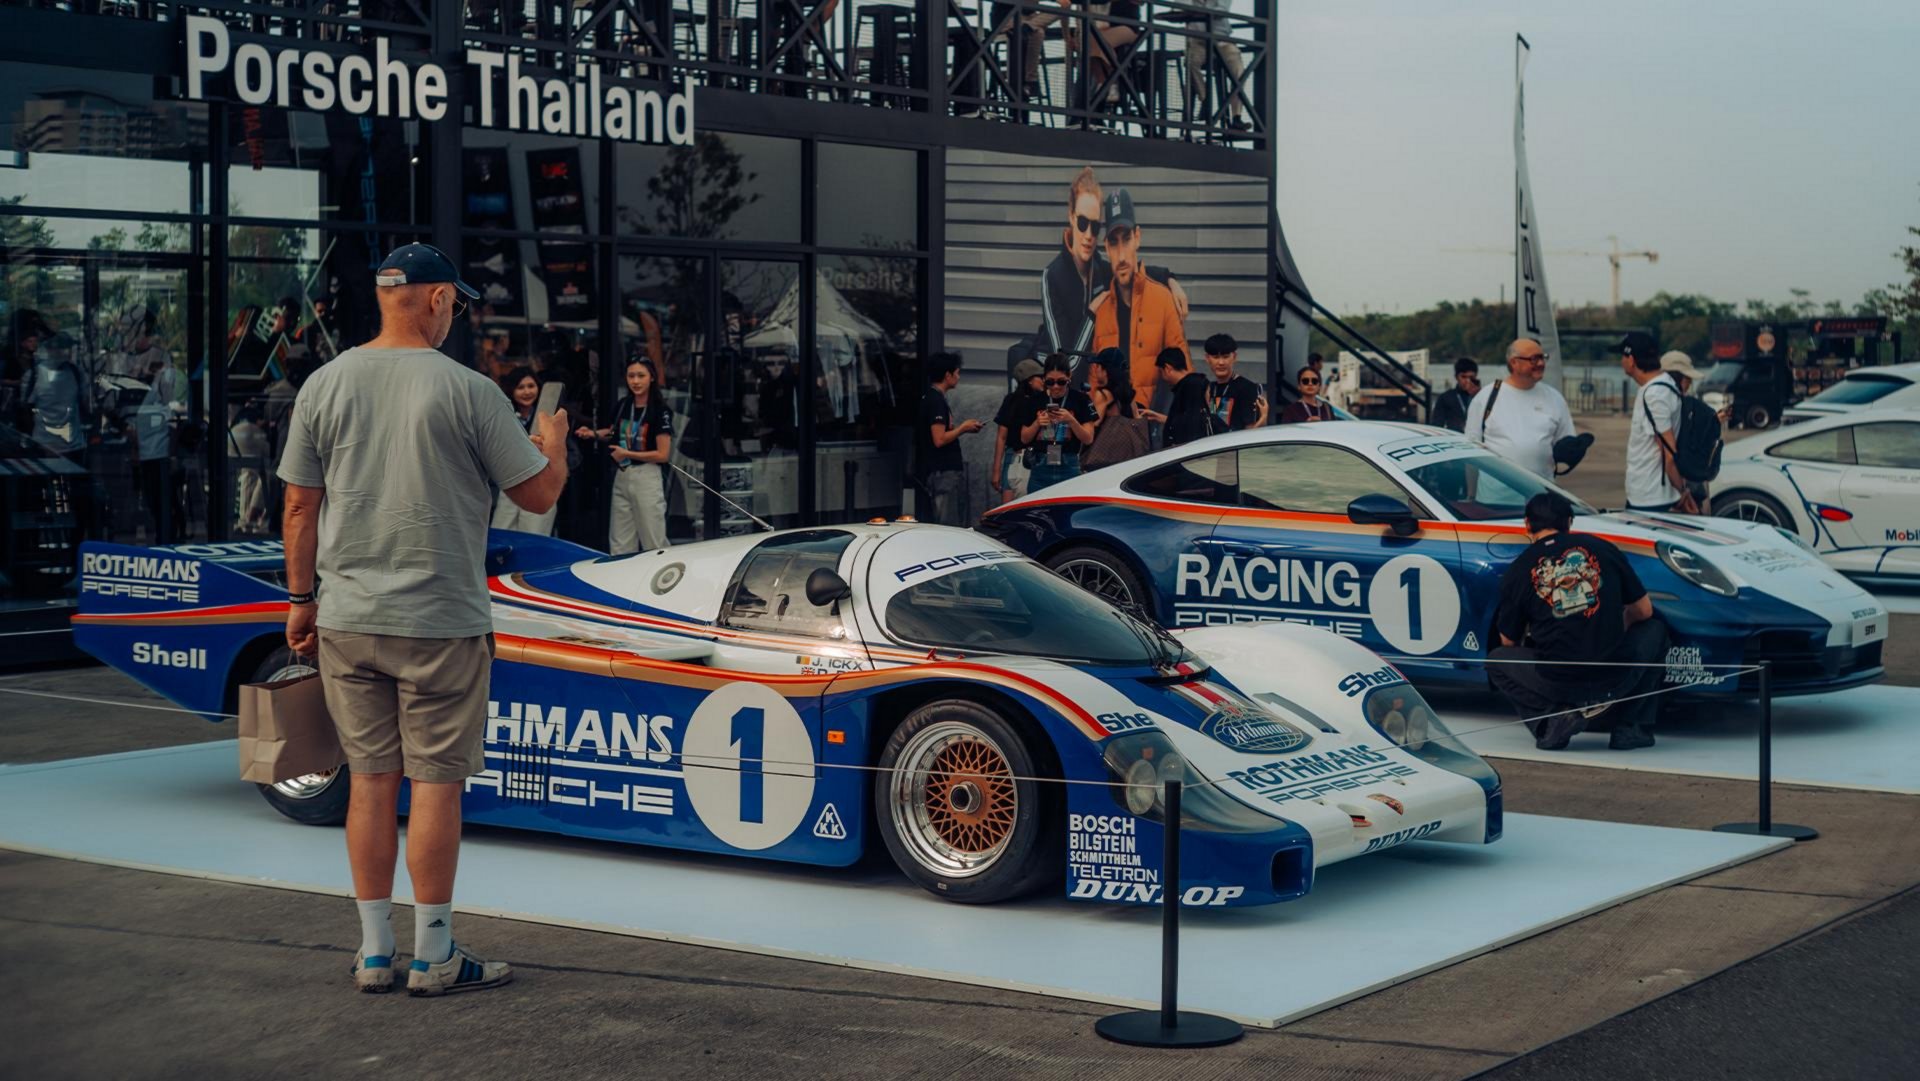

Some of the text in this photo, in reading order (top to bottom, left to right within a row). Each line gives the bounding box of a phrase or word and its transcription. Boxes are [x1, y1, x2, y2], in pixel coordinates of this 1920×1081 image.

[186, 15, 696, 146] Porsche Thailand
[83, 553, 201, 582] ROTHMANS
[1175, 553, 1361, 607] RACING
[82, 581, 200, 603] PORSCHE
[1400, 565, 1423, 640] 1
[133, 642, 206, 670] Shell
[828, 659, 863, 671] ICKX
[1338, 666, 1403, 697] Shell
[486, 701, 673, 763] HMANS
[1222, 722, 1293, 745] Rothmans
[729, 706, 765, 824] 1
[1226, 744, 1388, 790] ROTHMANS
[1266, 765, 1419, 805] PORSCHE
[1069, 814, 1135, 835] BOSCH
[1069, 832, 1136, 853] BILSTEIN
[1069, 850, 1142, 866] SCHMITTHELM
[1069, 864, 1158, 883] TELETRON
[1069, 879, 1245, 905] DUNOP
